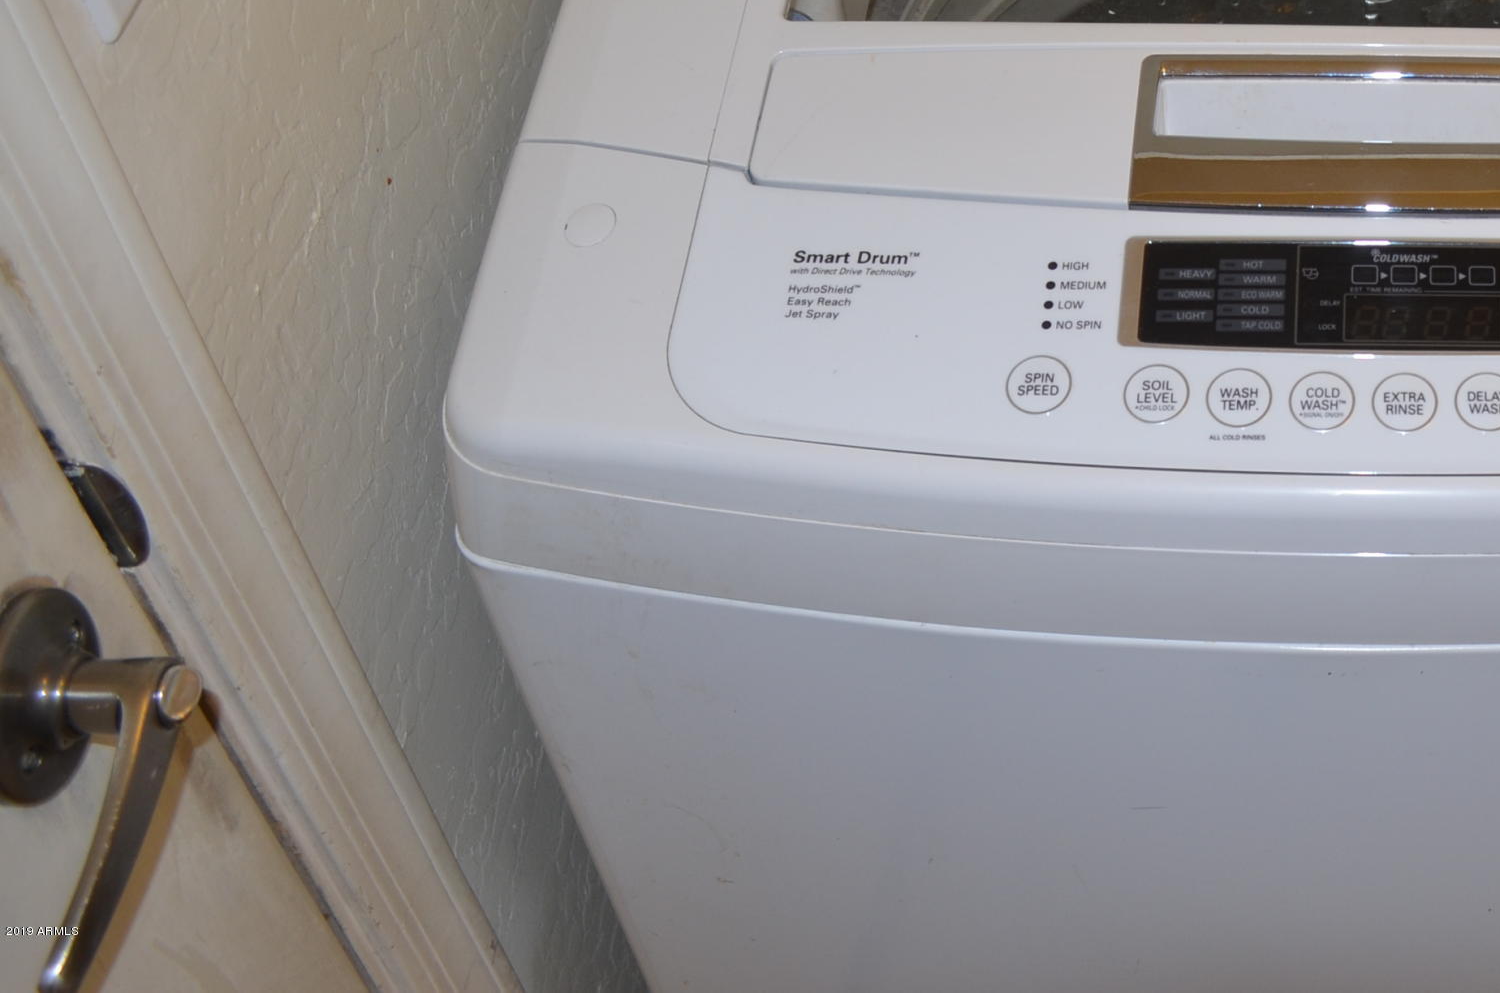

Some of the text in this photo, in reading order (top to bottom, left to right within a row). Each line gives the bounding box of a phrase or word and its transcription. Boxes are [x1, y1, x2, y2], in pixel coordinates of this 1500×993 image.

[793, 250, 850, 264] Smart
[1062, 262, 1089, 270] HIGH
[1242, 260, 1264, 268] HOT
[790, 267, 916, 278] with Direct Drive Technology
[1179, 269, 1213, 278] HEAVY
[1242, 276, 1277, 284] WARM
[1060, 281, 1107, 290] MEDIUM
[1178, 290, 1212, 299] NORMAL
[1241, 290, 1283, 299] ECO WARM
[787, 297, 852, 307] Easy Reach
[1058, 300, 1084, 309] LOW
[784, 310, 839, 320] Jet Spray
[1241, 305, 1269, 315] COLD
[1176, 311, 1206, 321] LIGHT
[1056, 321, 1102, 329] NO SPIN
[1259, 321, 1281, 330] COLD
[1024, 373, 1055, 384] SPIN
[1017, 385, 1059, 396] SPEED
[1142, 380, 1173, 391] SOIL
[1220, 387, 1258, 398] WASH
[1306, 387, 1340, 398] COLD
[1383, 392, 1426, 403] EXTRA
[1136, 392, 1178, 404] LEVEL
[1221, 400, 1259, 411] TEMP.
[1386, 404, 1424, 415] RINSE
